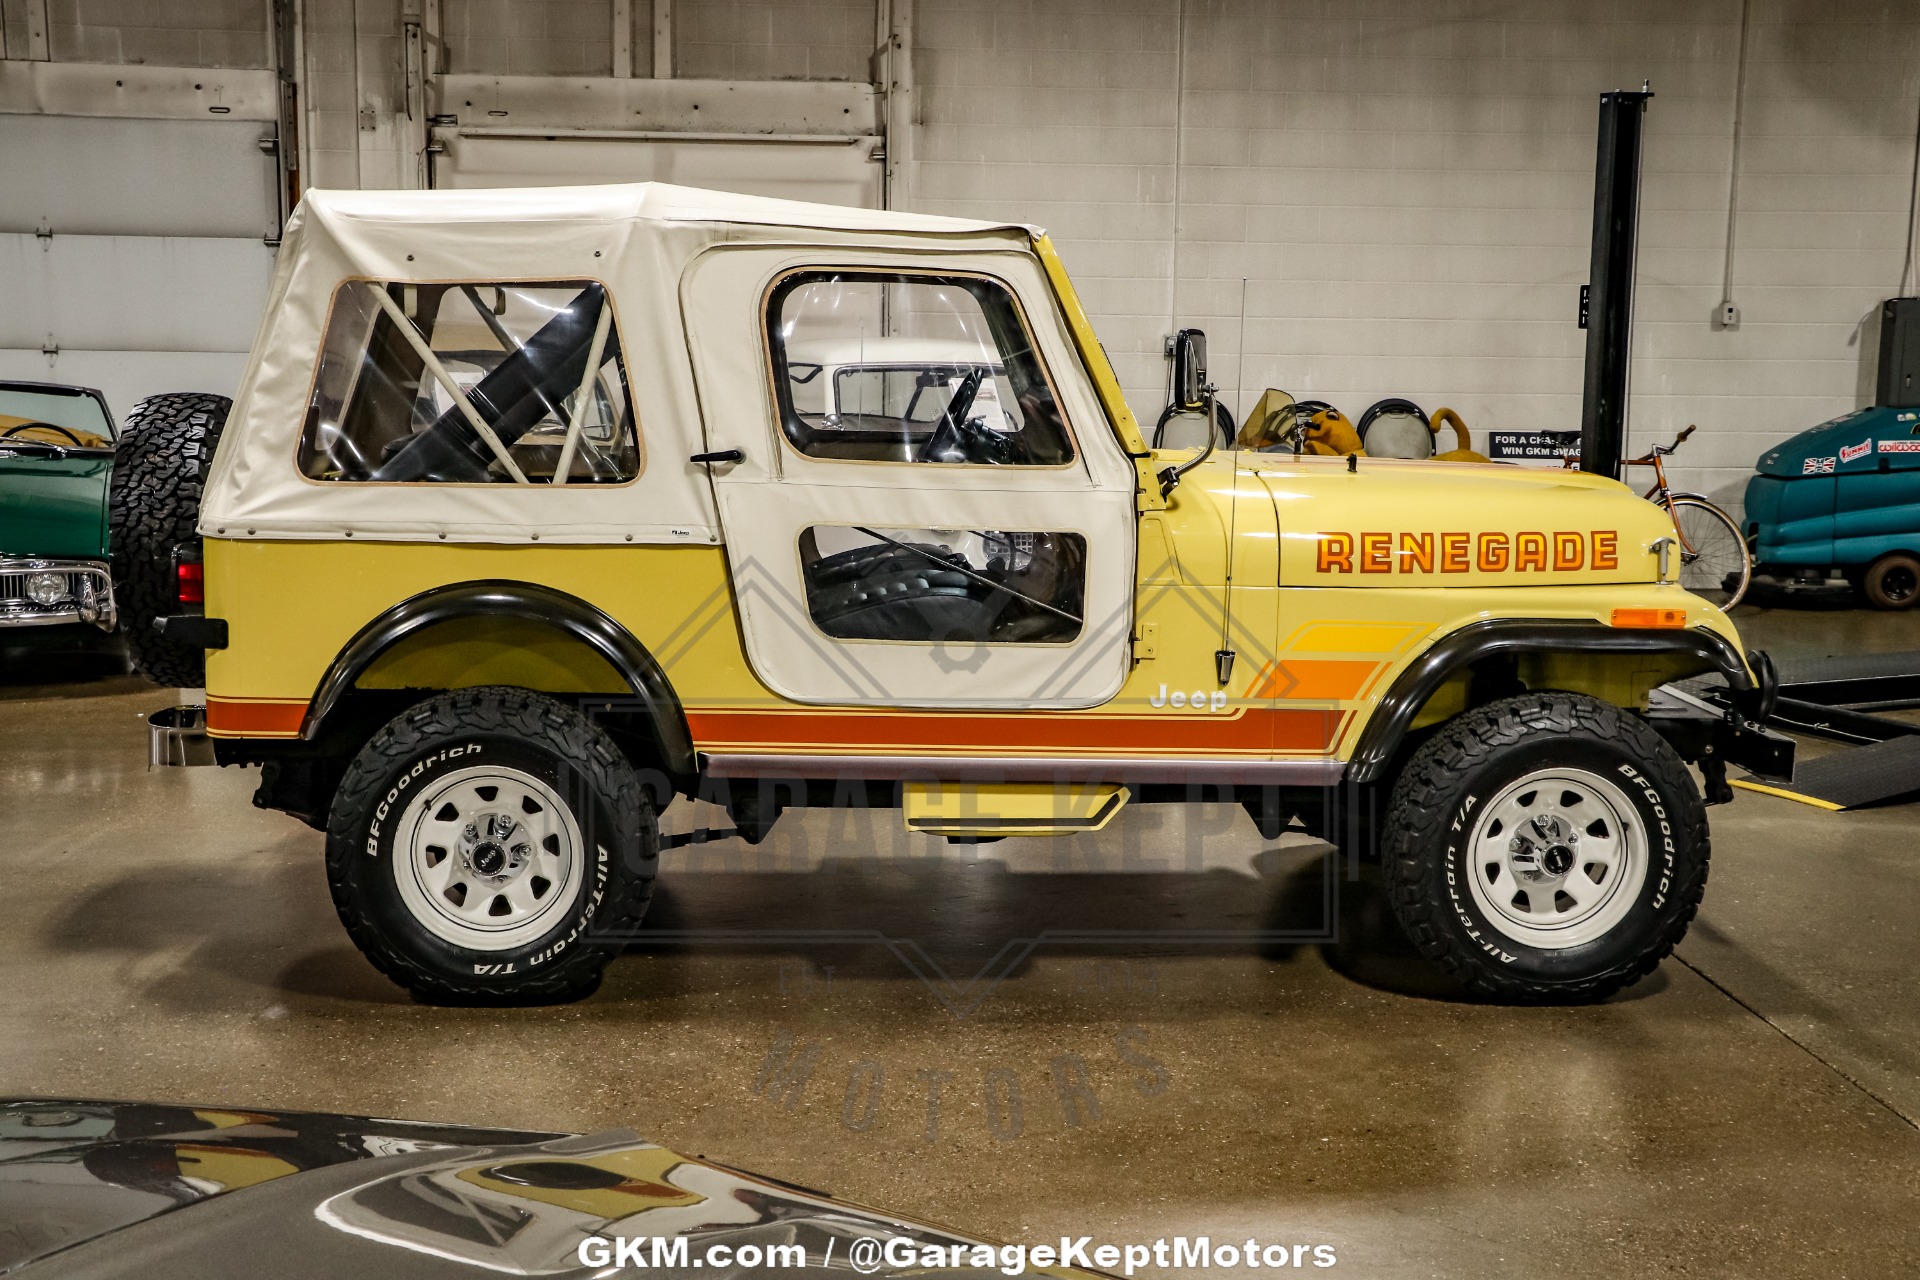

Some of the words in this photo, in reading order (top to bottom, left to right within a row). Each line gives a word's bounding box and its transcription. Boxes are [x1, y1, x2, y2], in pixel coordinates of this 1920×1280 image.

[1495, 435, 1516, 444] FOR
[1519, 436, 1527, 444] A
[1502, 446, 1522, 455] WIN
[1526, 447, 1550, 456] GKM
[1316, 530, 1618, 574] RENEGADE
[1149, 683, 1228, 713] Jeep
[366, 743, 482, 857] BFGoodrich
[1450, 794, 1478, 833] T/A
[1617, 763, 1676, 910] BFGoodrich
[529, 843, 609, 967] All-Terrain
[1444, 846, 1518, 964] All-Terrain
[473, 963, 518, 976] T/A
